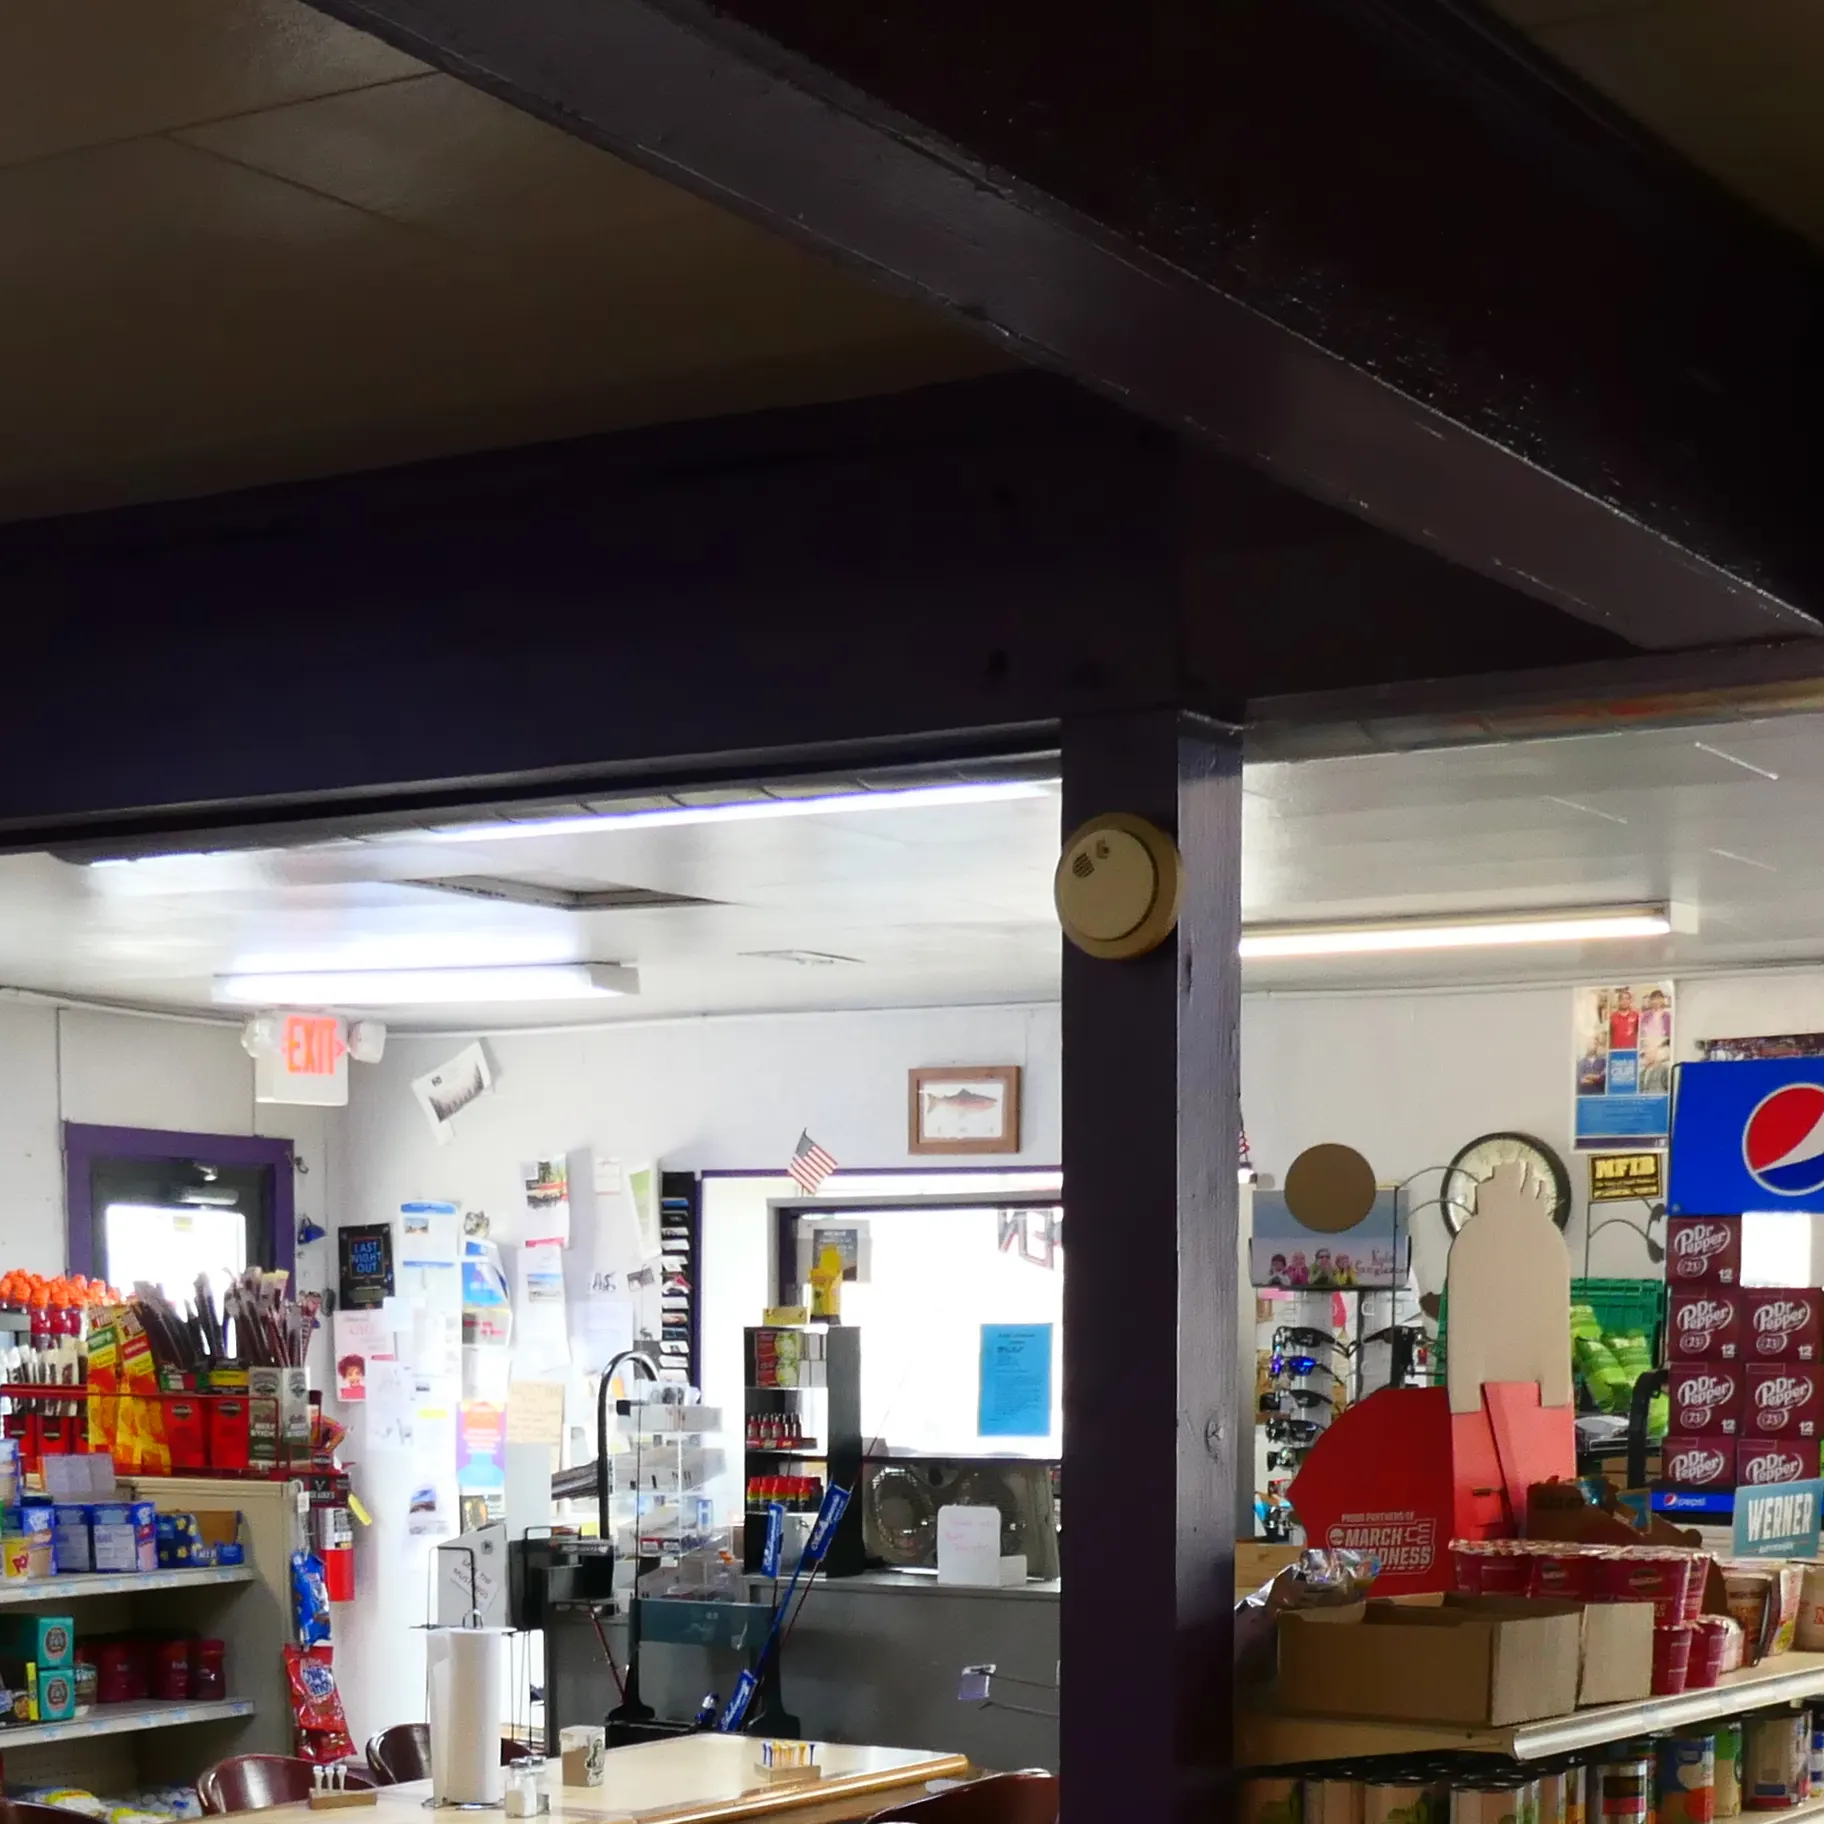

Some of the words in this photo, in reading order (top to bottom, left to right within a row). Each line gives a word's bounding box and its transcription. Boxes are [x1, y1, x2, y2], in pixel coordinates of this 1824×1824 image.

[288, 1016, 337, 1074] EXIT
[1678, 1228, 1727, 1256] Pepper
[1693, 1224, 1714, 1238] Dr
[1682, 1304, 1729, 1331] Pepper
[1697, 1301, 1717, 1314] Dr
[1759, 1306, 1807, 1333] Pepper
[1774, 1302, 1794, 1315] Dr
[1682, 1380, 1729, 1407] Pepper
[1697, 1376, 1717, 1389] Dr
[1759, 1382, 1808, 1408] Pepper
[1775, 1377, 1796, 1389] Dr
[1674, 1455, 1720, 1481] Pepper
[1687, 1451, 1708, 1463] Dr
[1765, 1454, 1786, 1466] Dr
[1750, 1458, 1798, 1483] Pepper
[1747, 1493, 1814, 1542] WERNER
[1344, 1527, 1403, 1548] MARCH
